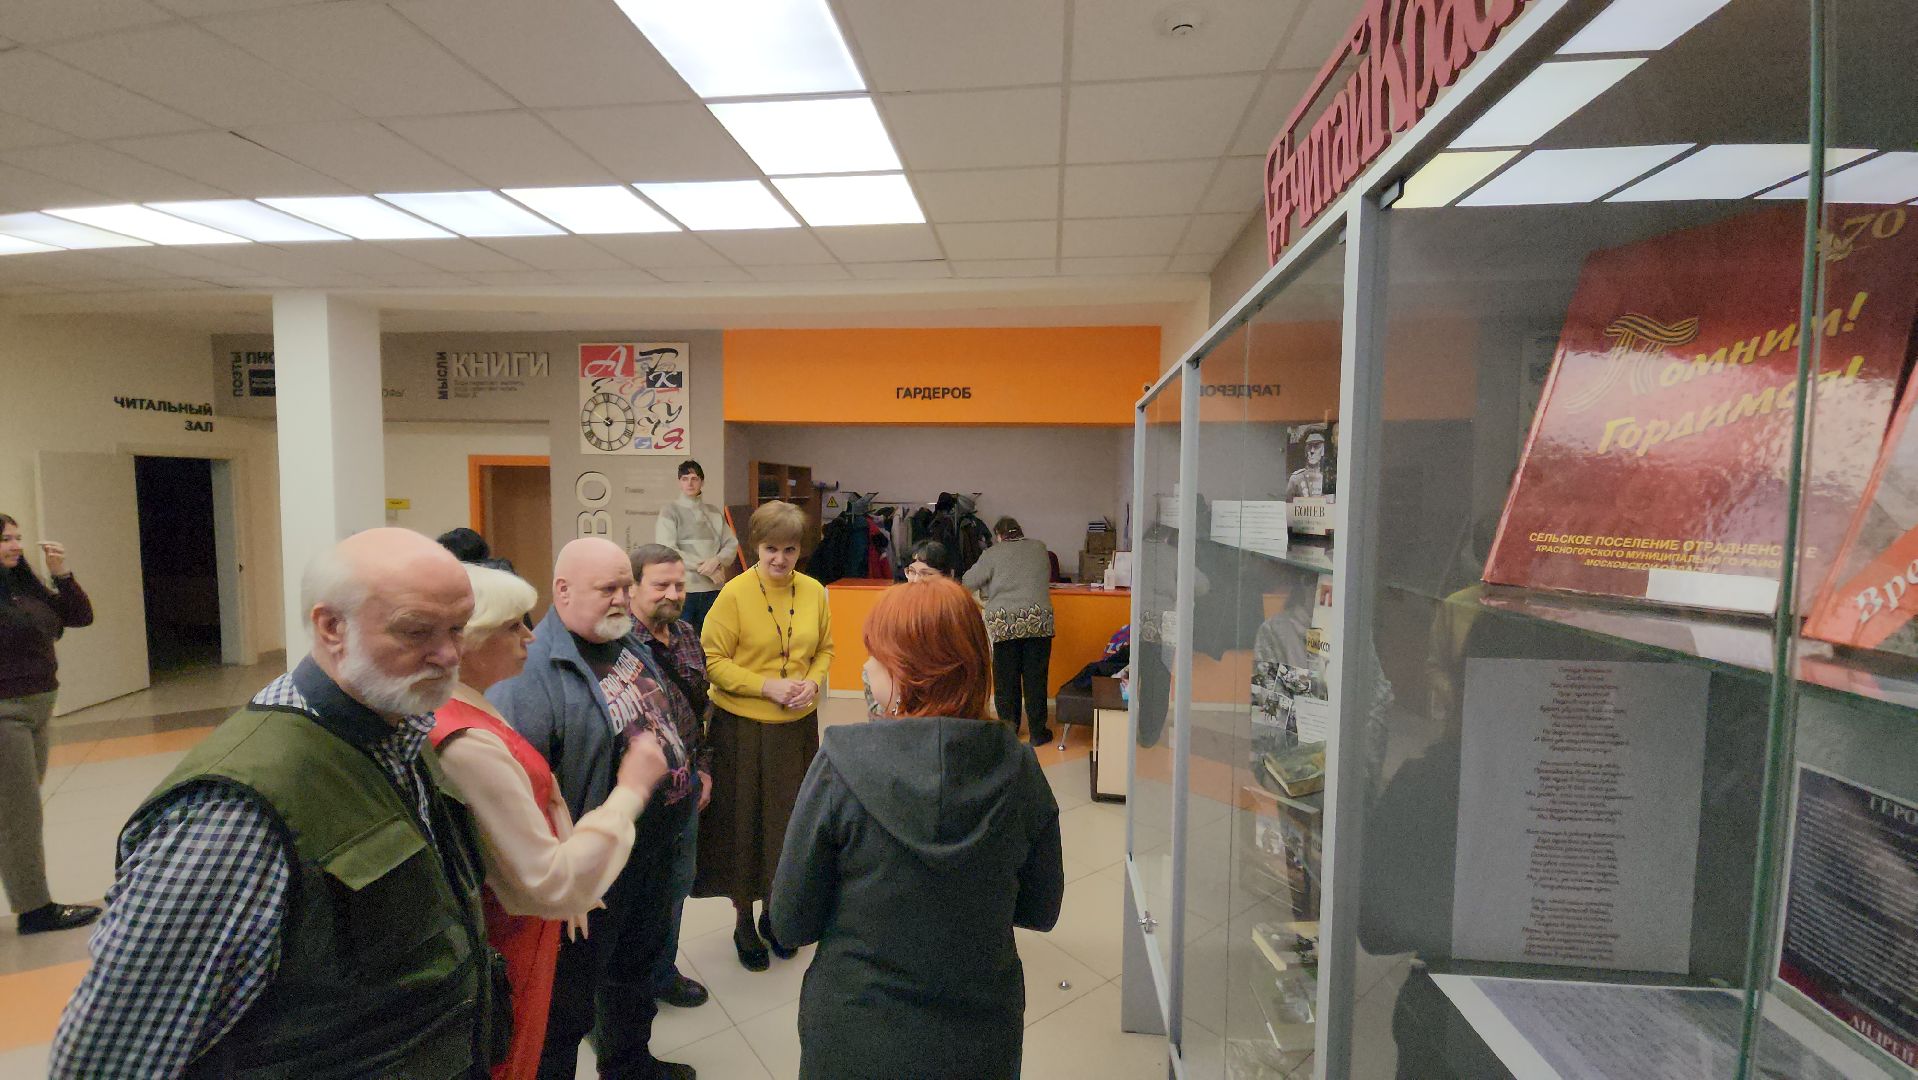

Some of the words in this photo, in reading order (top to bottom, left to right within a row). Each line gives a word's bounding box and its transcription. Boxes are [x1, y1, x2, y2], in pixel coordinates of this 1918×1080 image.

[231, 352, 244, 398] ПОЭТЫ
[436, 352, 449, 400] МЫСЛИ
[451, 352, 550, 377] КНИГИ
[895, 386, 972, 401] ГАРДЕРОБ
[113, 395, 213, 416] ЧИТАЛЬНЫЙ
[184, 420, 213, 433] ЗАЛ
[1529, 532, 1593, 546] СЕЛЬСКОЕ
[1595, 534, 1681, 551] ПОСЕЛЕНИЕ
[1683, 540, 1818, 559] ОТРАДНЕНСЕ
[1535, 545, 1624, 558] КРАСНОГОРСКОГО
